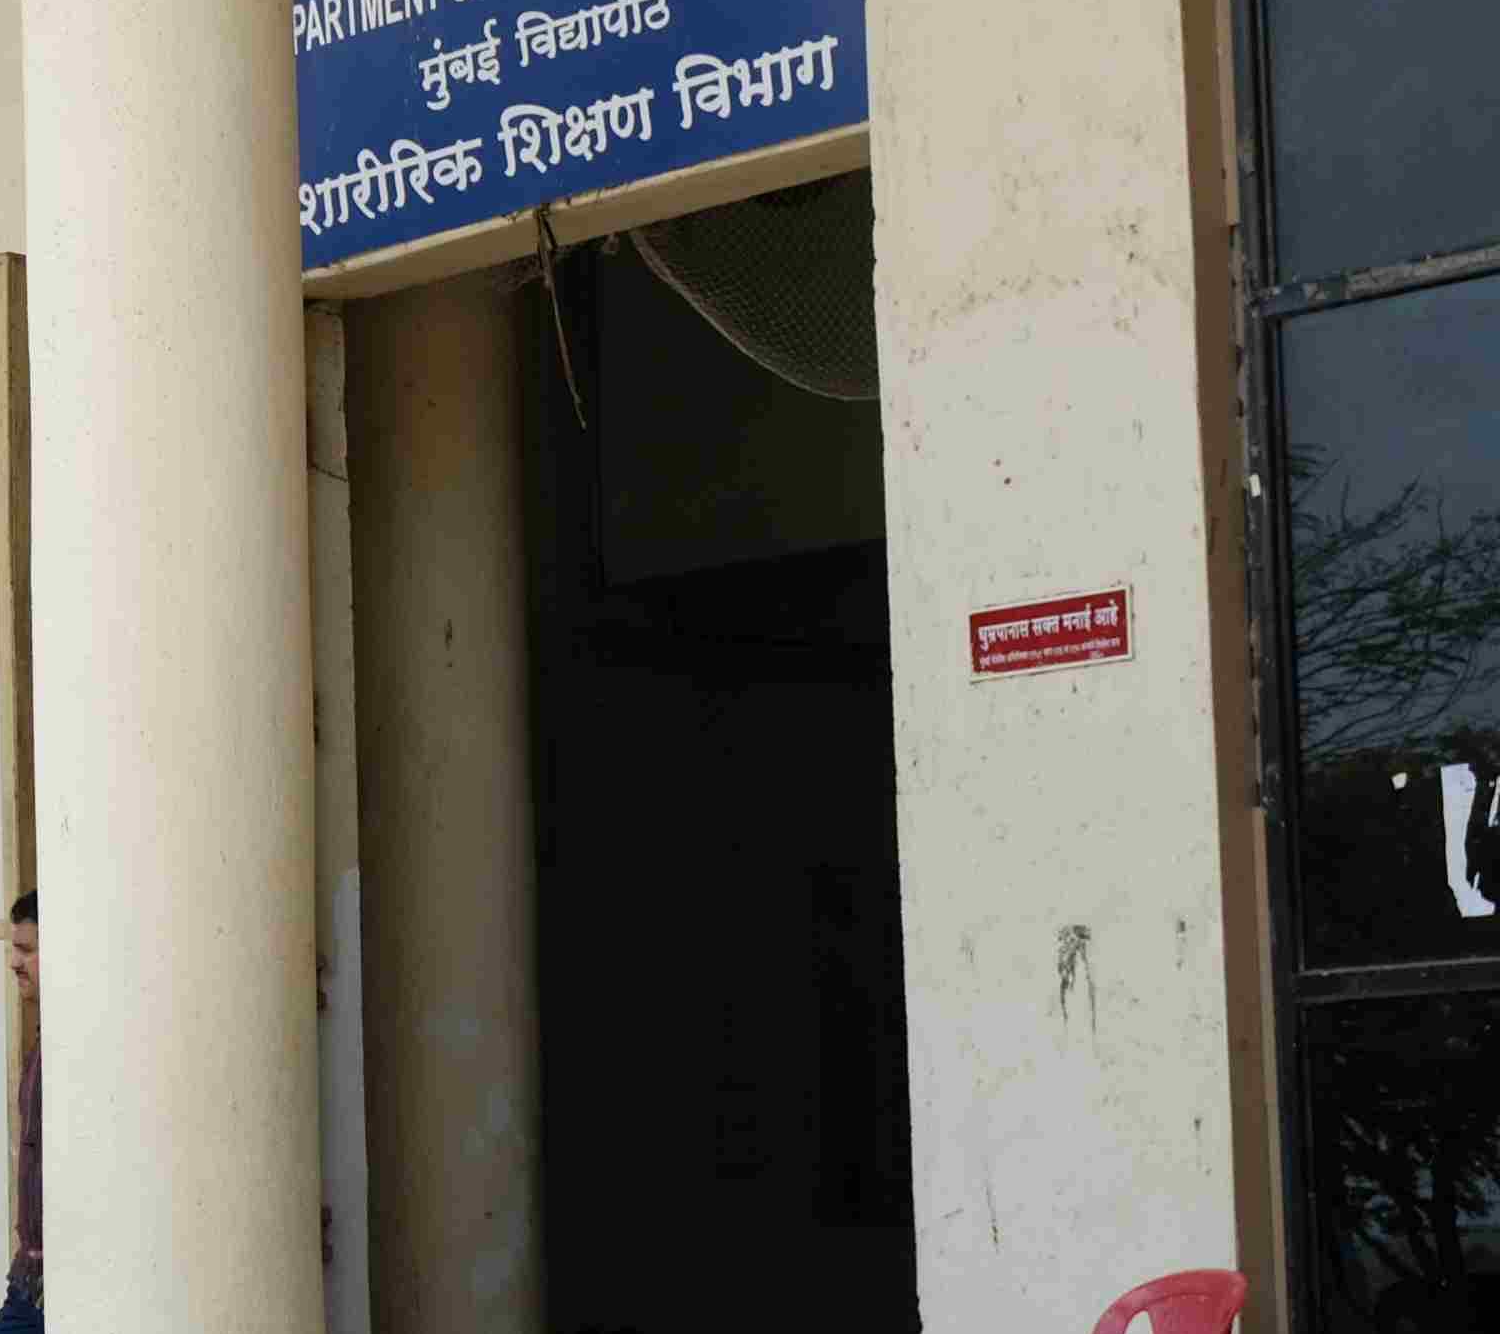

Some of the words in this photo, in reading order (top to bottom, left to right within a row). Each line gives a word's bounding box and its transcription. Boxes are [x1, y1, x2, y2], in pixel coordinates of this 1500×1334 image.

[418, 18, 501, 111] मुंबई
[298, 138, 483, 236] शारीरिक
[497, 87, 655, 177] शिक्षण
[673, 35, 839, 129] विभाग
[1061, 603, 1093, 632] मनाई
